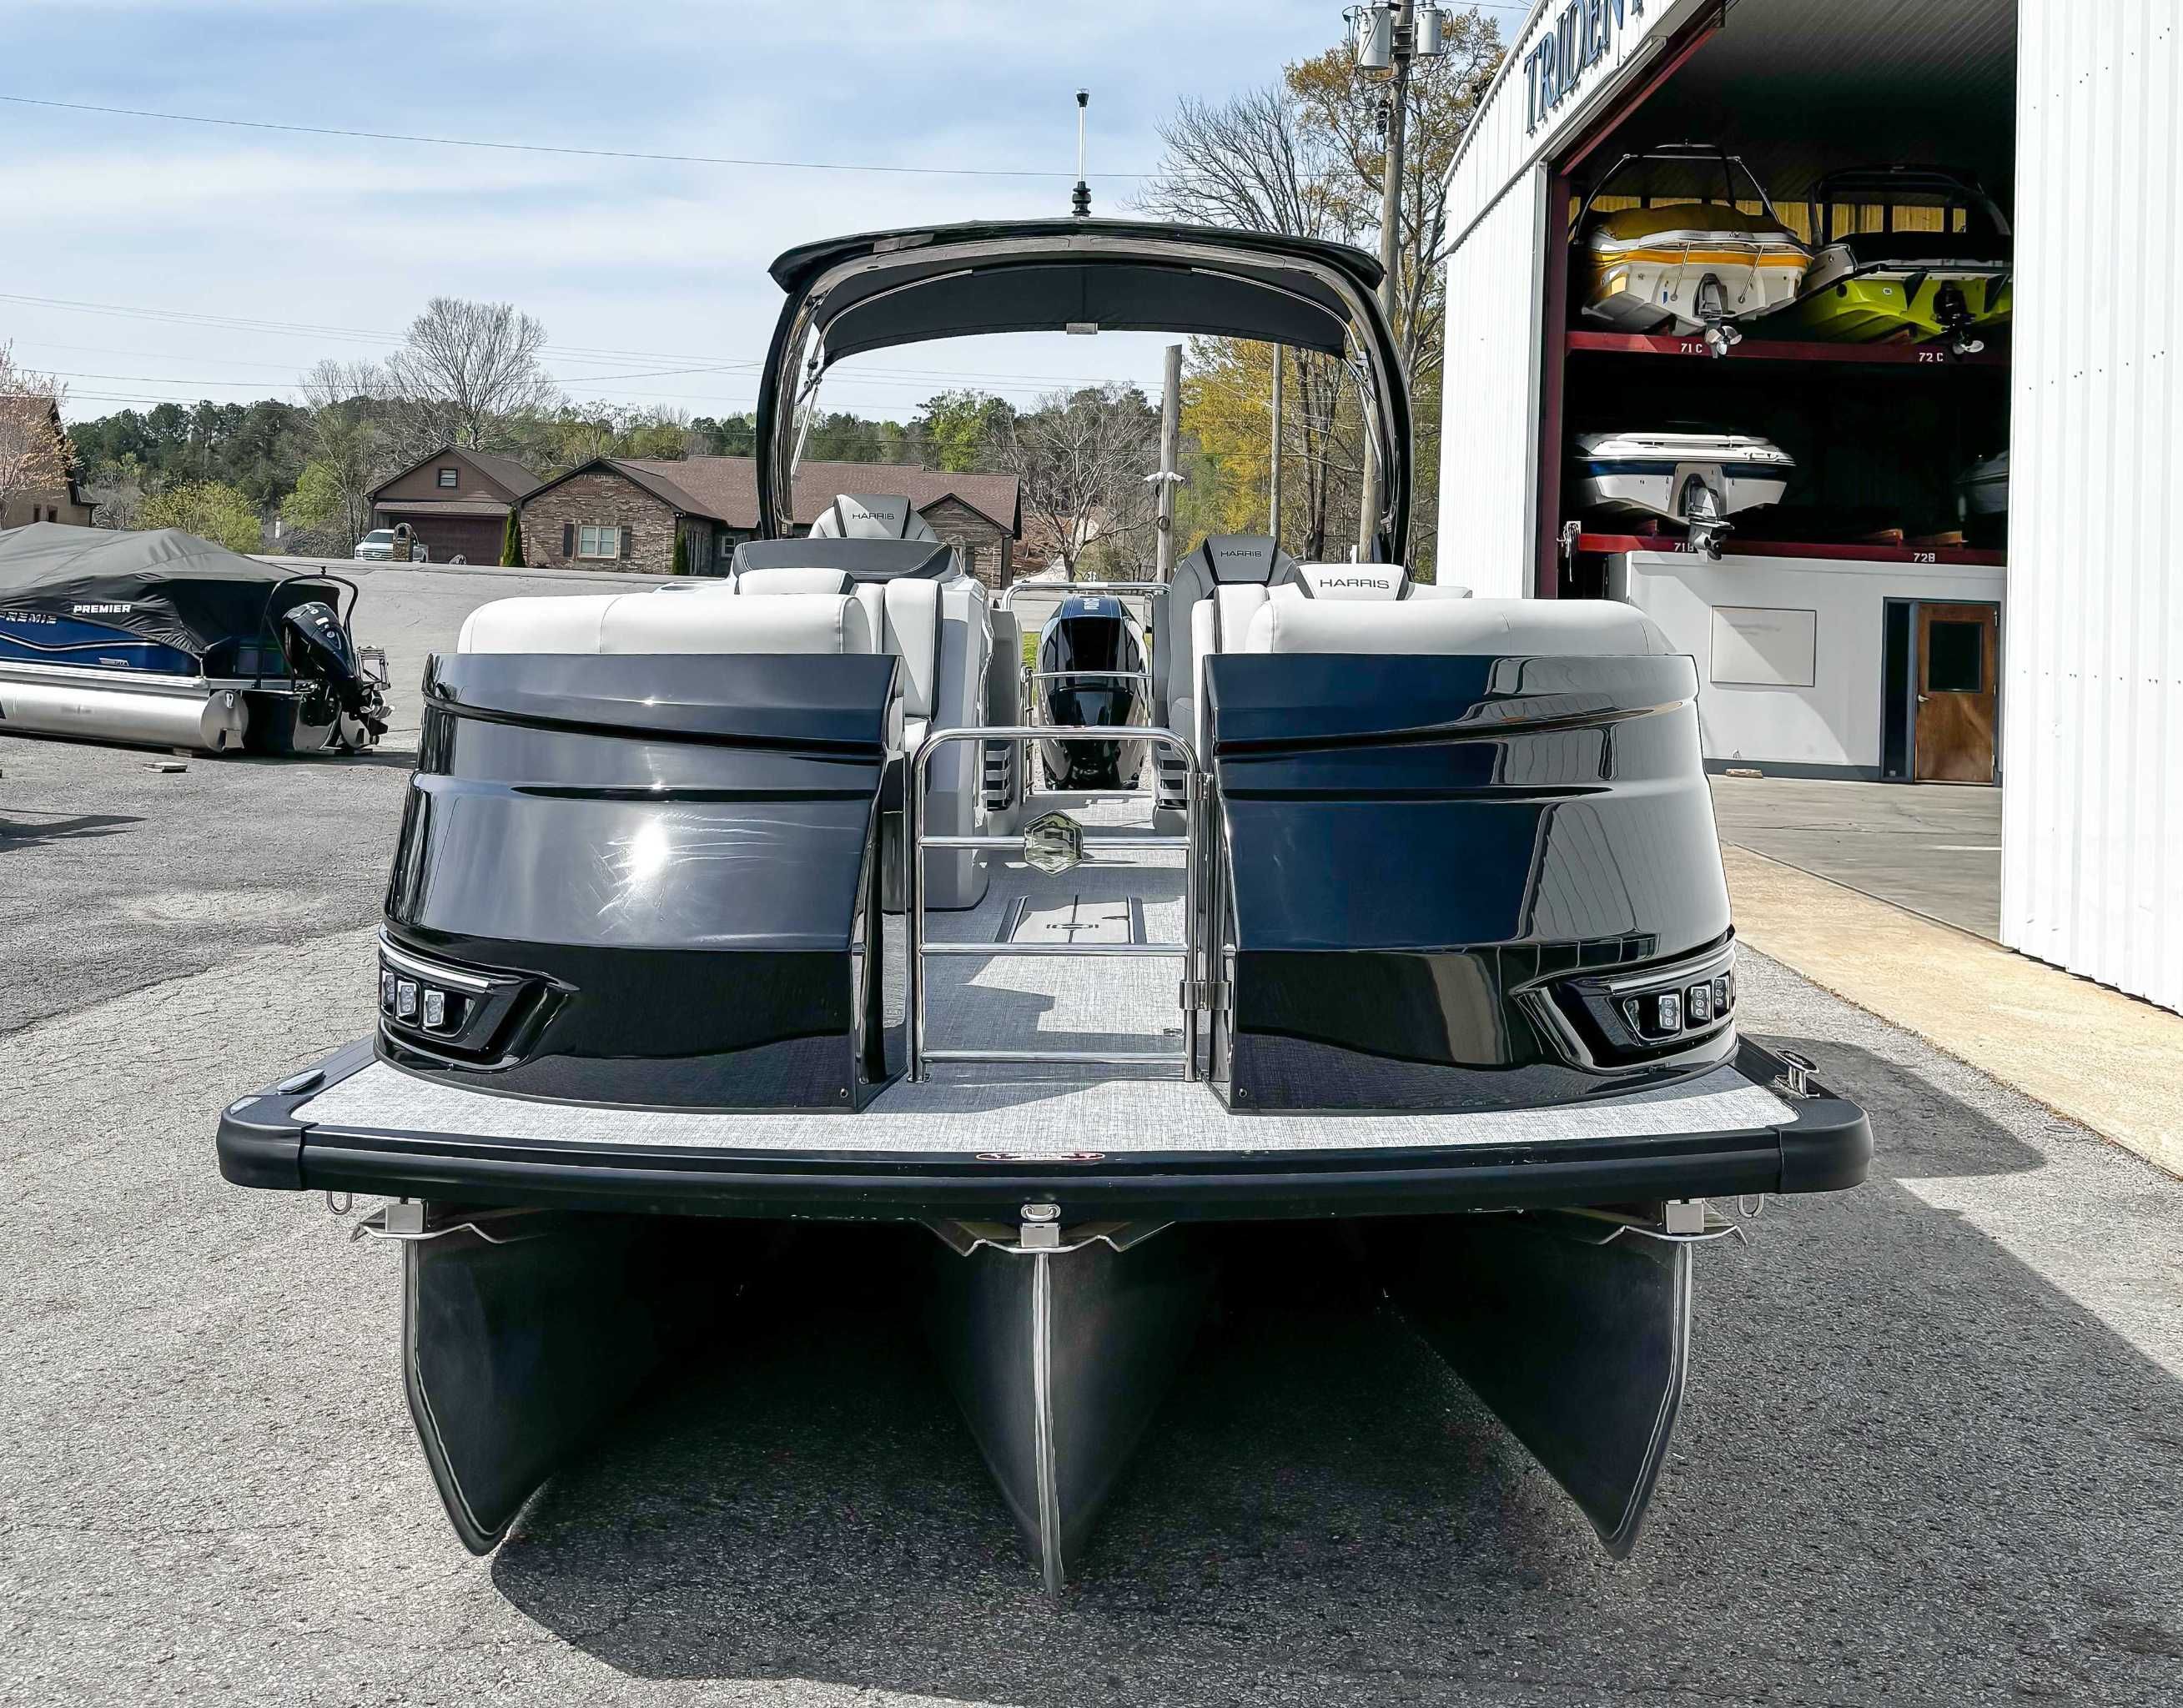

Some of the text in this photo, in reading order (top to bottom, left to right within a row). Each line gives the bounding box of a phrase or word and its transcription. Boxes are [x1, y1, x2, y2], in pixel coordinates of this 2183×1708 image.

[1524, 0, 1641, 134] TRIDE
[1681, 343, 1703, 354] 71 C
[1919, 352, 1944, 362] 72 C
[1320, 579, 1390, 589] HARRIS
[73, 604, 132, 614] PREMIER
